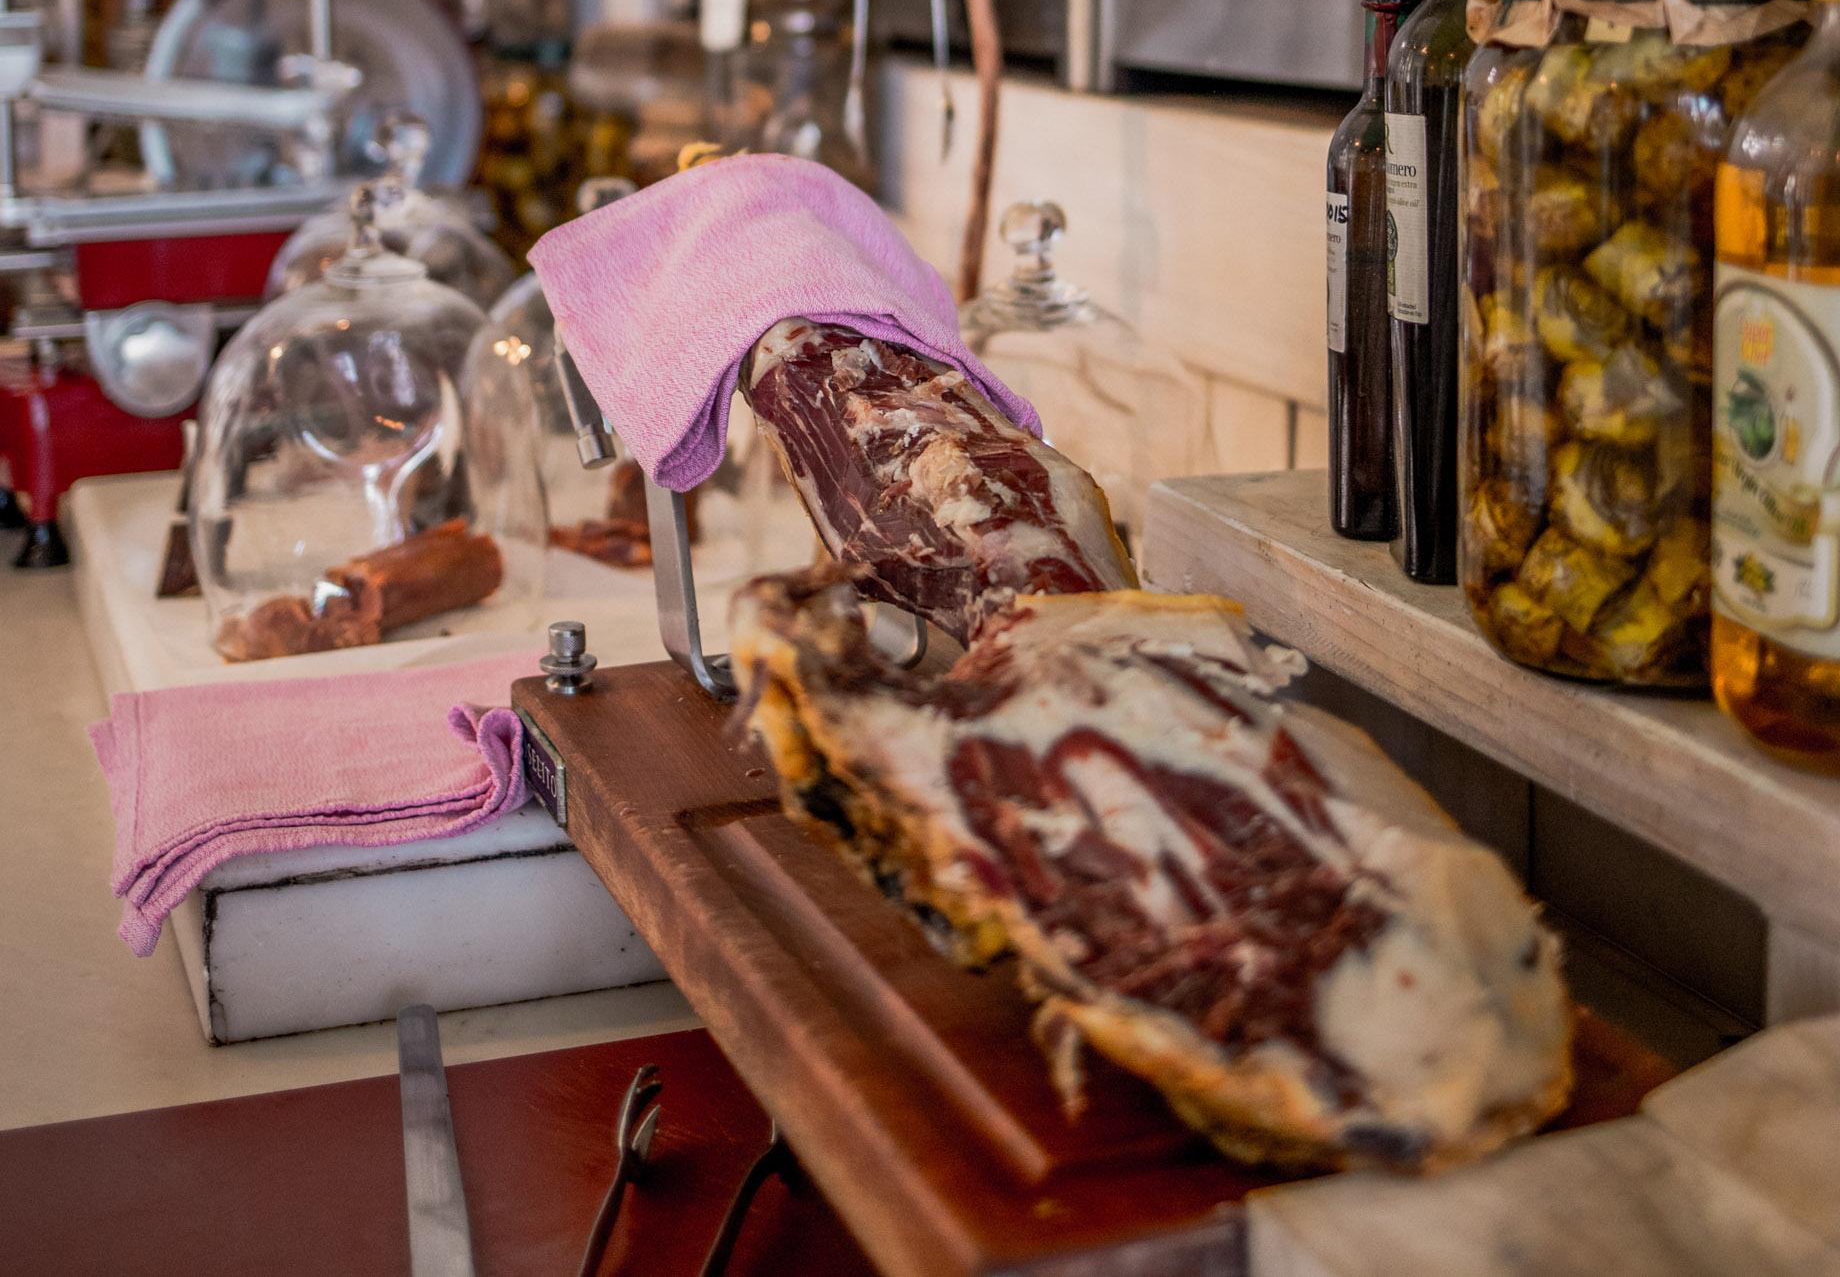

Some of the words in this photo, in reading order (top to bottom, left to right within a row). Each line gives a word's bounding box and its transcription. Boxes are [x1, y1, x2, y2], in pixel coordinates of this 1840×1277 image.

[1386, 162, 1417, 178] omero
[1326, 202, 1348, 224] 015
[526, 742, 557, 798] SELITO
